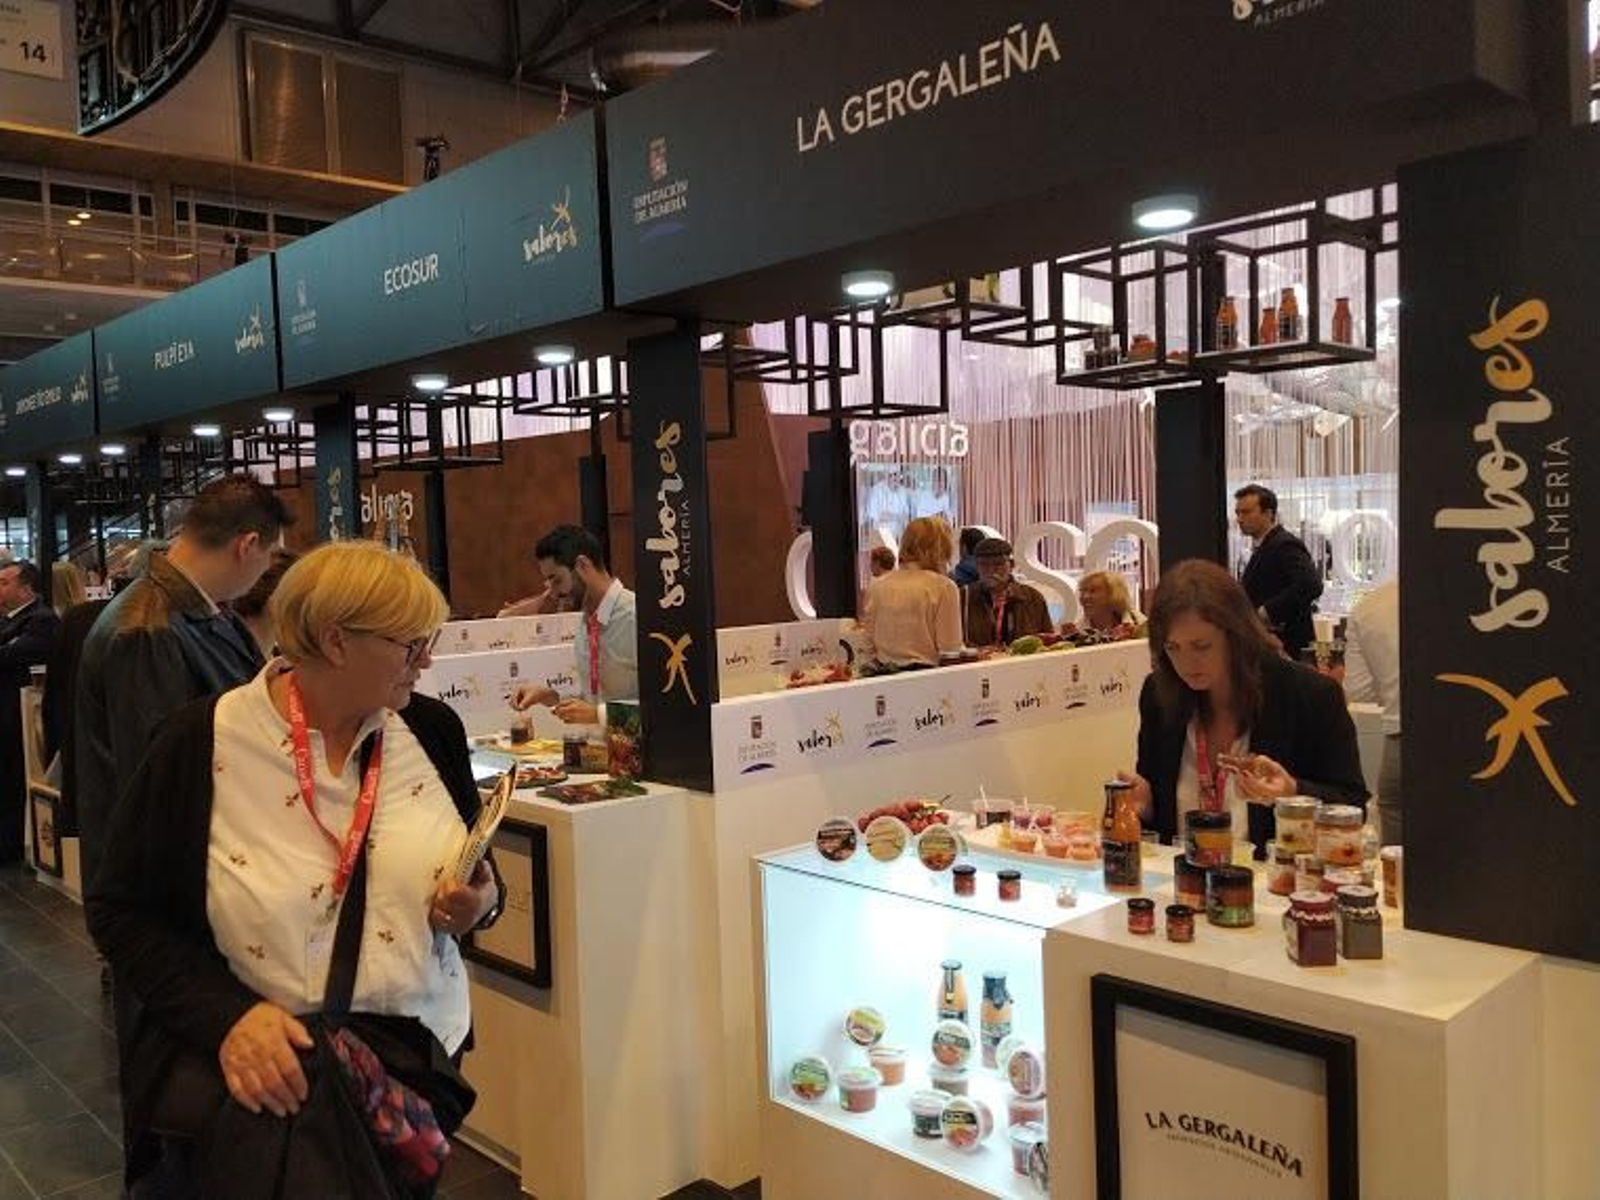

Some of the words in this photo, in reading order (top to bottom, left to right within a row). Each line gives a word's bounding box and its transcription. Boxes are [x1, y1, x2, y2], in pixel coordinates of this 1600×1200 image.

[20, 41, 46, 63] 14
[797, 108, 834, 152] LA
[841, 22, 1061, 134] GERGALEÑA
[384, 253, 439, 295] ECOSUR
[849, 419, 969, 464] galicia
[1434, 295, 1553, 633] sabores
[645, 419, 686, 610] sabores
[1545, 436, 1571, 574] ALMERÍA
[1145, 1111, 1172, 1129] LA
[1178, 1114, 1303, 1178] GERGALEÑA
